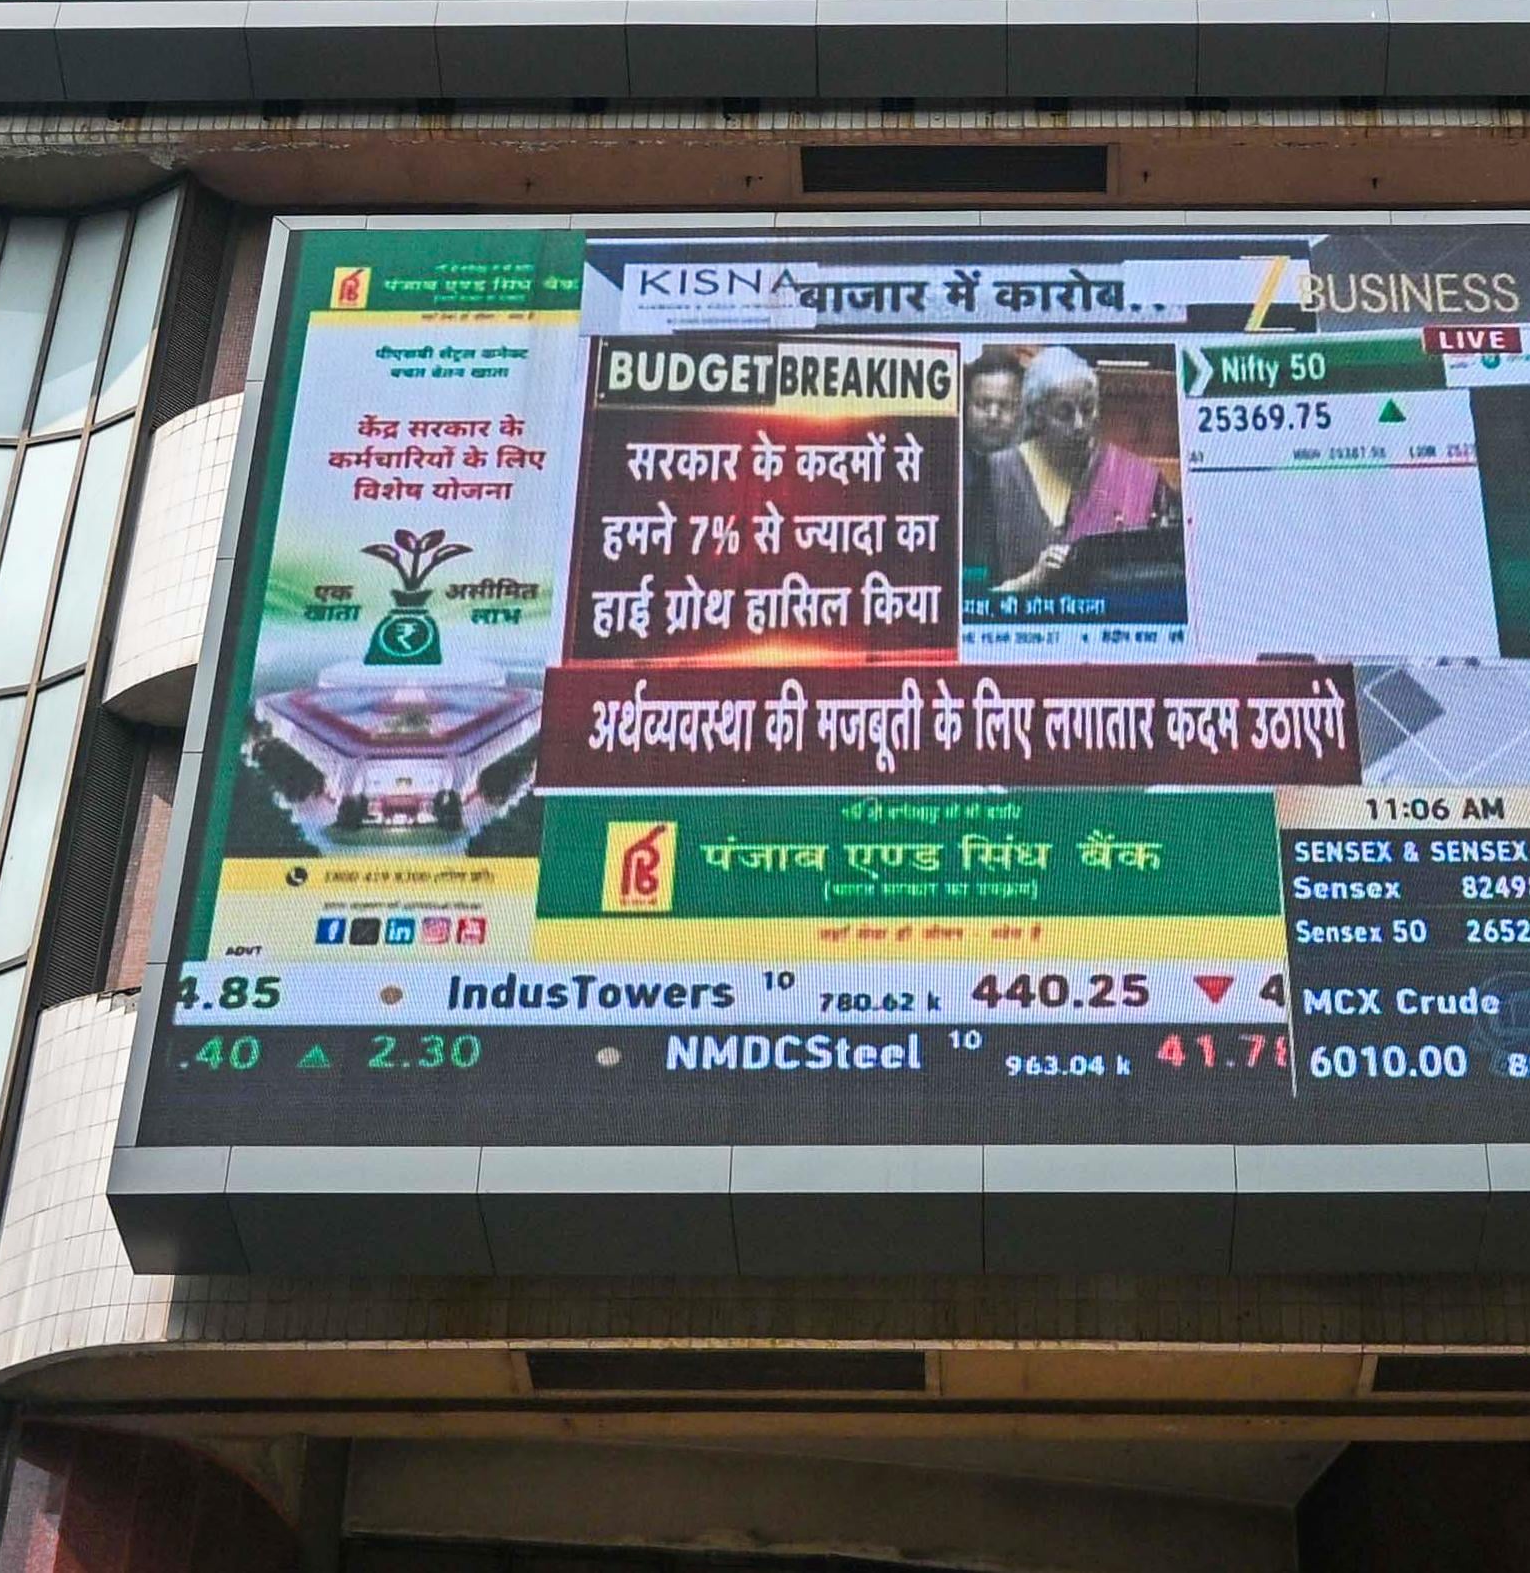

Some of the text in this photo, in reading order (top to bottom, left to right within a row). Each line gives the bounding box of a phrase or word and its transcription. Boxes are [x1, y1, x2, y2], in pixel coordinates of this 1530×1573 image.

[639, 269, 799, 296] KISNA
[1299, 272, 1520, 313] BUSINESS
[1439, 330, 1506, 350] LIVE
[608, 351, 952, 399] BUDGET BREAKING
[1221, 353, 1326, 387] Nifty 50
[408, 420, 492, 438] सरकार
[499, 414, 525, 438] के
[1198, 402, 1331, 433] 25369.75
[328, 445, 547, 470] कर्मचारियों के लिए
[627, 430, 923, 485] सरकार के कदमों से
[353, 476, 514, 500] विशेष योजना
[602, 501, 939, 561] हमने 7% से ज्यादा का
[314, 585, 354, 602] एक
[592, 571, 942, 637] हाई ग्रोथ हासिल किया
[470, 606, 524, 625] लाभ
[588, 677, 1345, 773] अर्थव्यवस्था की मजबूती के लिए लगातार कदम उठाएंगे
[1366, 797, 1506, 821] 11:06 AM
[700, 836, 829, 872] पंजाब
[844, 844, 944, 880] एण्ड
[1076, 829, 1163, 871] बैंक
[1294, 841, 1392, 863] SENSEX
[1403, 842, 1420, 862] &
[1431, 840, 1529, 862] SENSEX
[1293, 877, 1401, 900] Sensex
[1296, 920, 1382, 943] Sensex
[1392, 919, 1427, 942] 50
[226, 945, 263, 957] ADVT
[448, 972, 736, 1009] IndusTowers
[764, 971, 796, 990] 10
[972, 973, 1150, 1008] 440.25
[1302, 987, 1501, 1015] MCX Crude
[368, 1034, 483, 1068] 2.30
[666, 1033, 922, 1070] NMDCSteel
[948, 1029, 983, 1051] 10
[1005, 1055, 1105, 1077] 963.04
[1309, 1046, 1468, 1077] 6010.00
